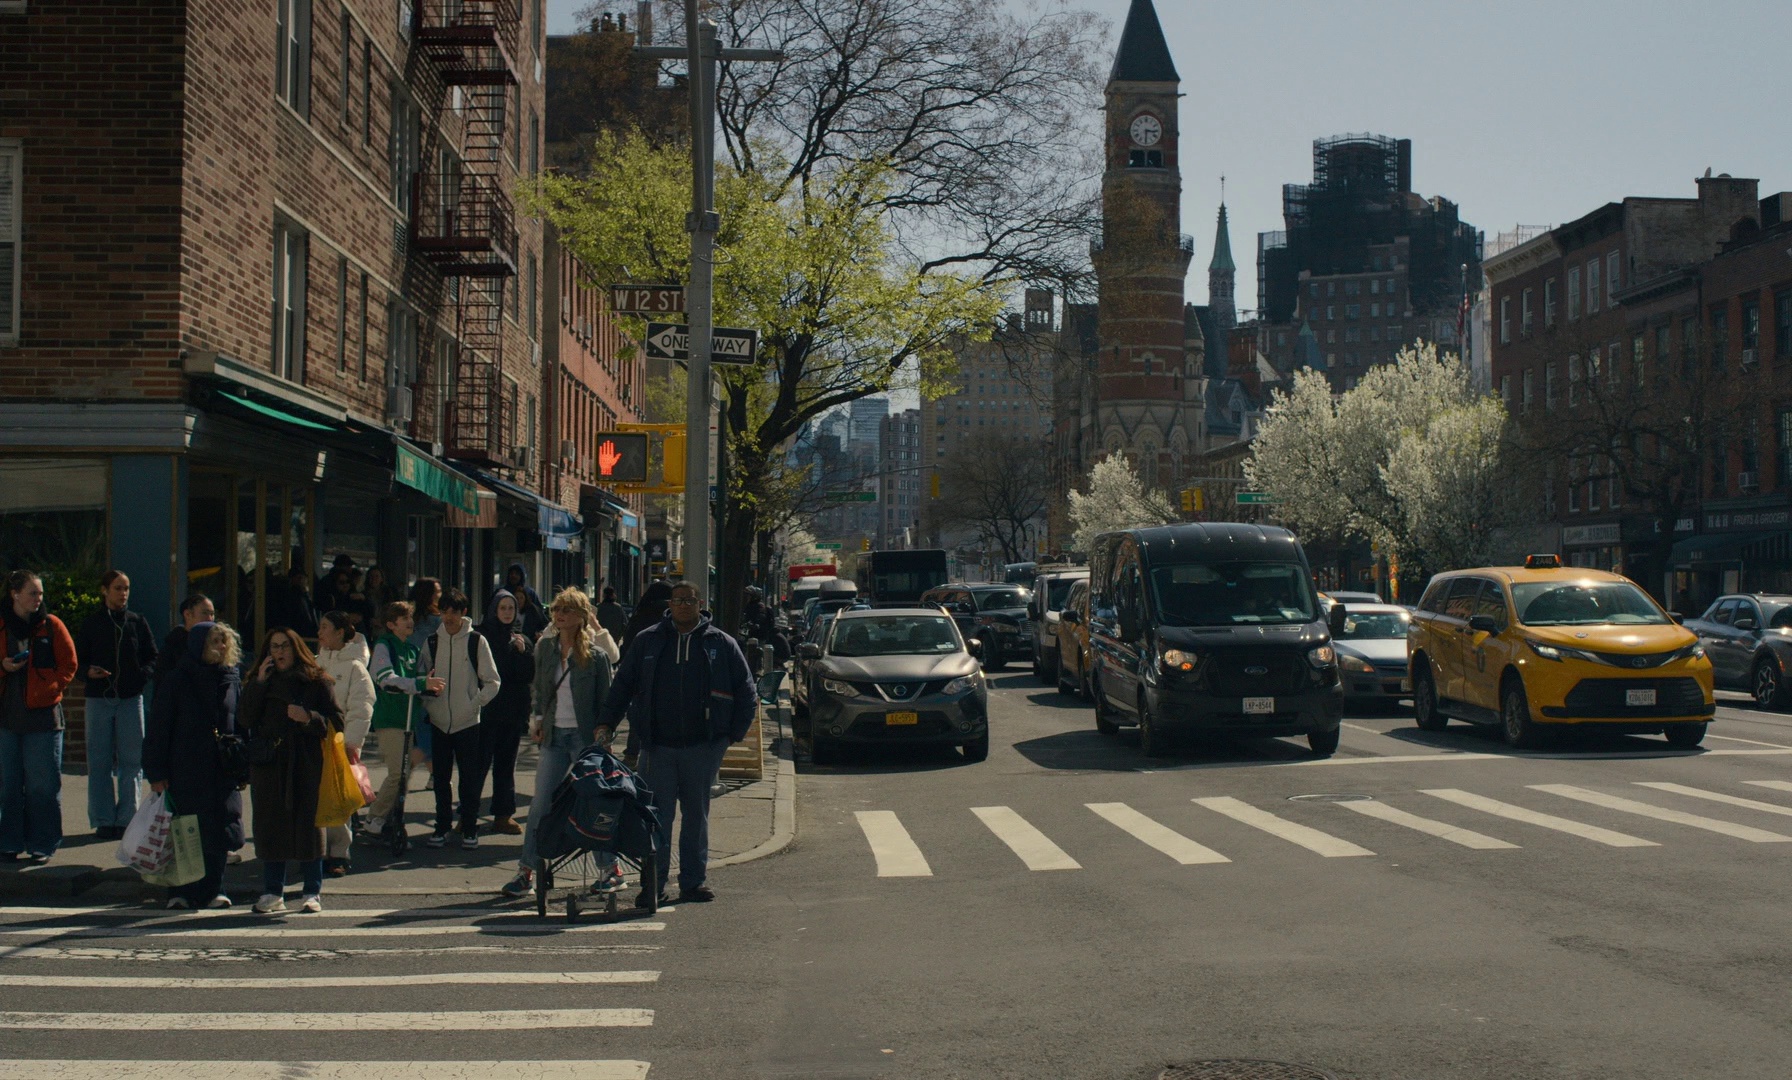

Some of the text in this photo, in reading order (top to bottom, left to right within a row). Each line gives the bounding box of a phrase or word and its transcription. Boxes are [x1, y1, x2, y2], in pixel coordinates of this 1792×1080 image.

[615, 290, 681, 311] W 12 ST
[661, 334, 747, 353] ONE WAY
[1733, 514, 1754, 526] FRUITS
[1760, 511, 1789, 524] GROCERY
